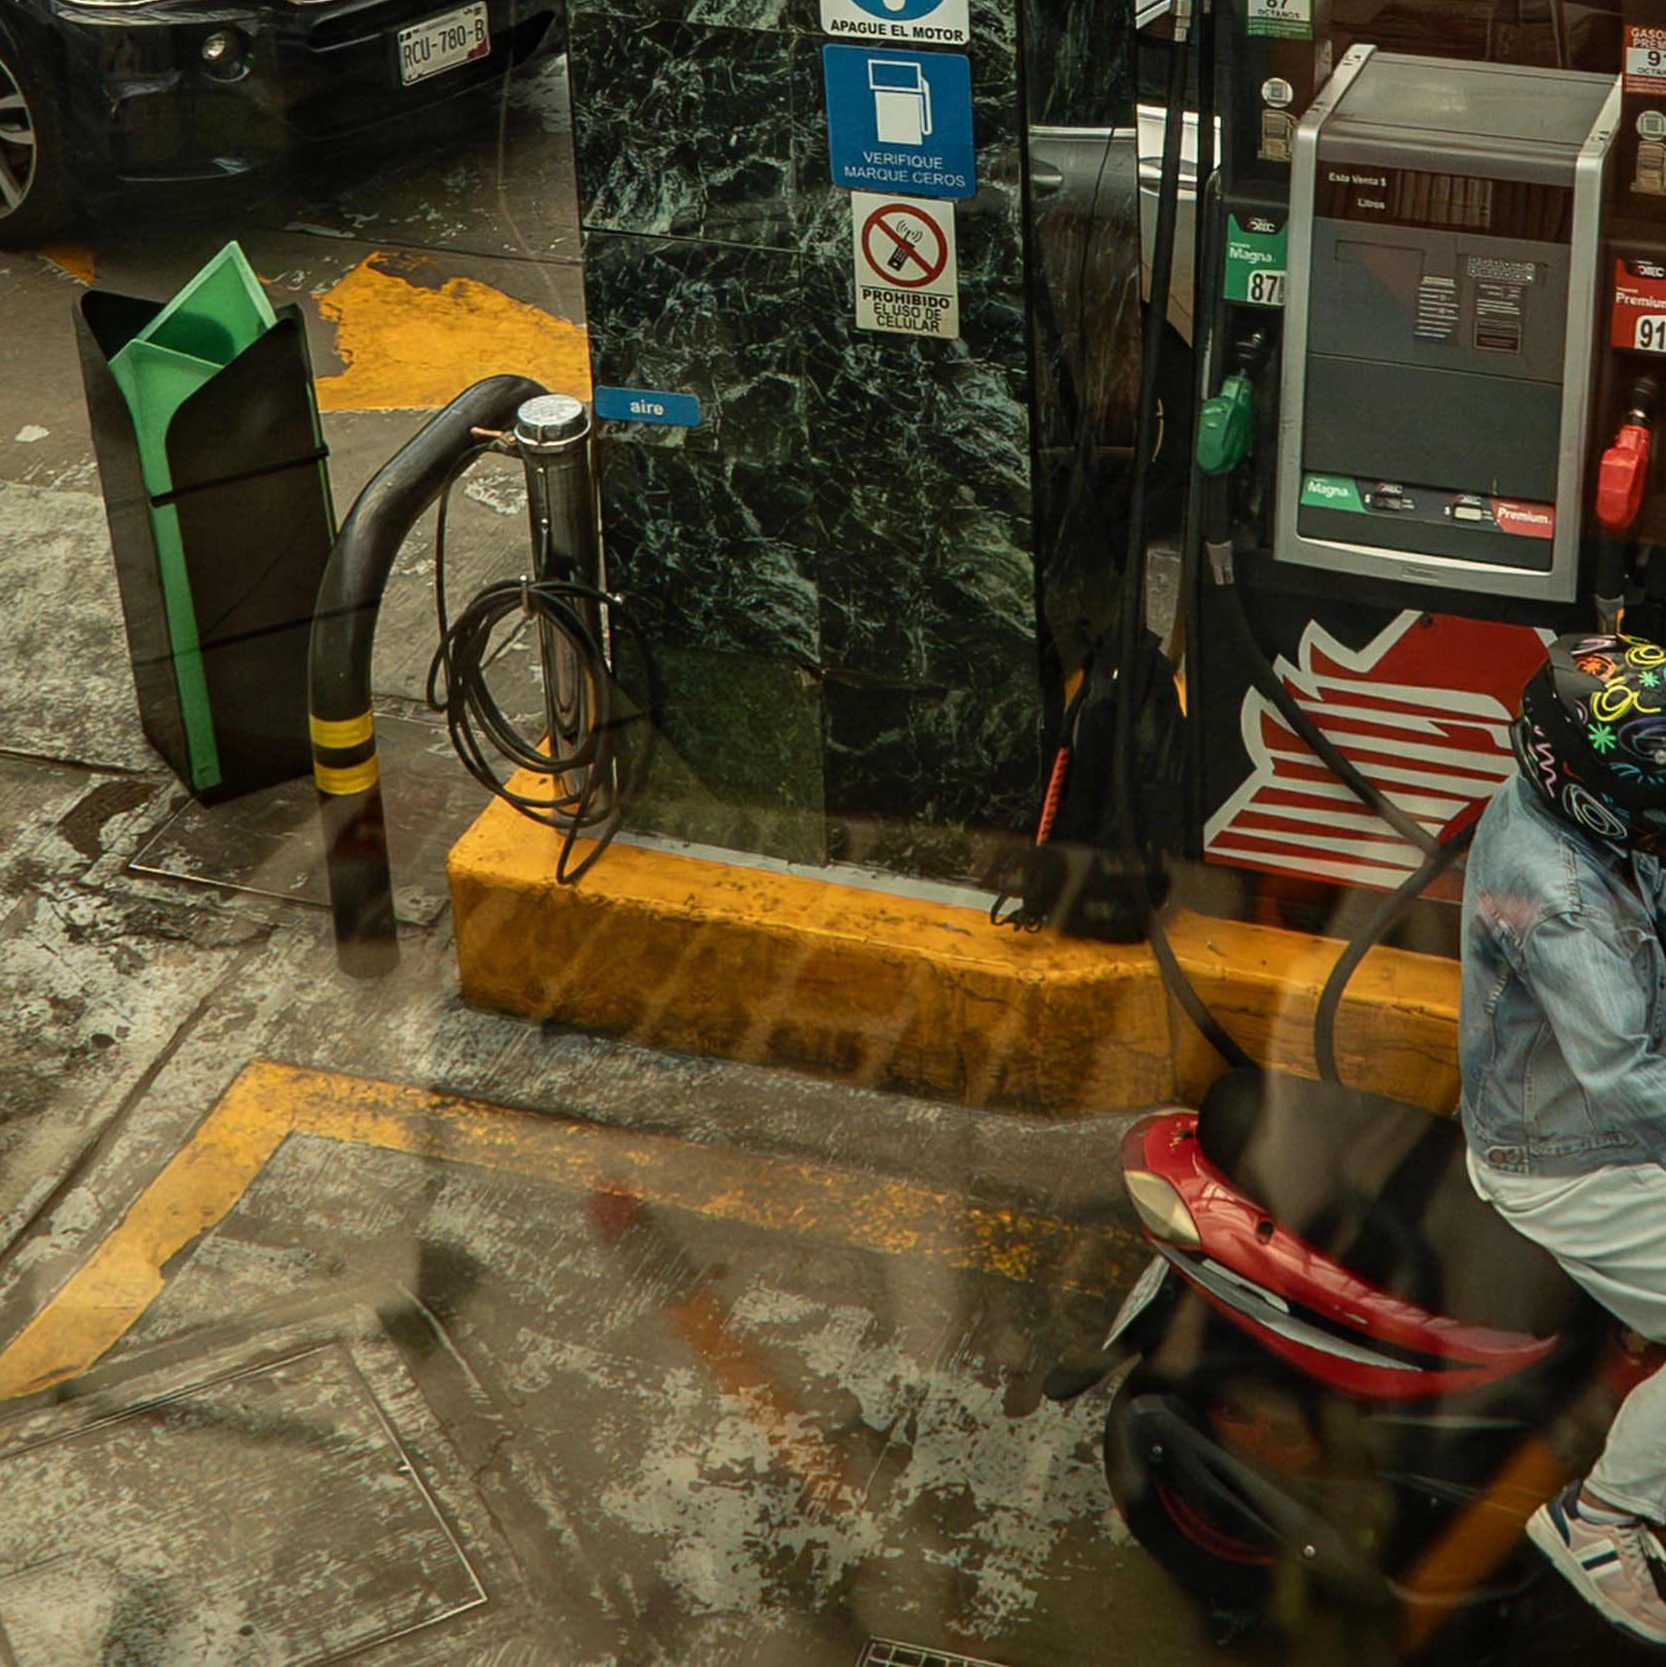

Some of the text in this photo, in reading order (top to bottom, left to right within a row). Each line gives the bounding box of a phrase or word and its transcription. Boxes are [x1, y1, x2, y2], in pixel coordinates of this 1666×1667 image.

[831, 20, 964, 42] APAGUE EL MOTOR
[403, 19, 485, 69] RCU-780-B
[863, 151, 943, 170] VERIFIQUE
[844, 166, 966, 187] MARQUE CEROS
[1229, 247, 1273, 264] Magna
[1250, 272, 1279, 303] 87
[862, 288, 950, 310] PROHIBIDO
[874, 302, 942, 321] EL USO DE
[876, 314, 940, 333] CELULAR
[1639, 318, 1666, 350] 91
[629, 398, 665, 415] aire
[1308, 481, 1350, 498] Magna
[1497, 506, 1550, 525] Premium
